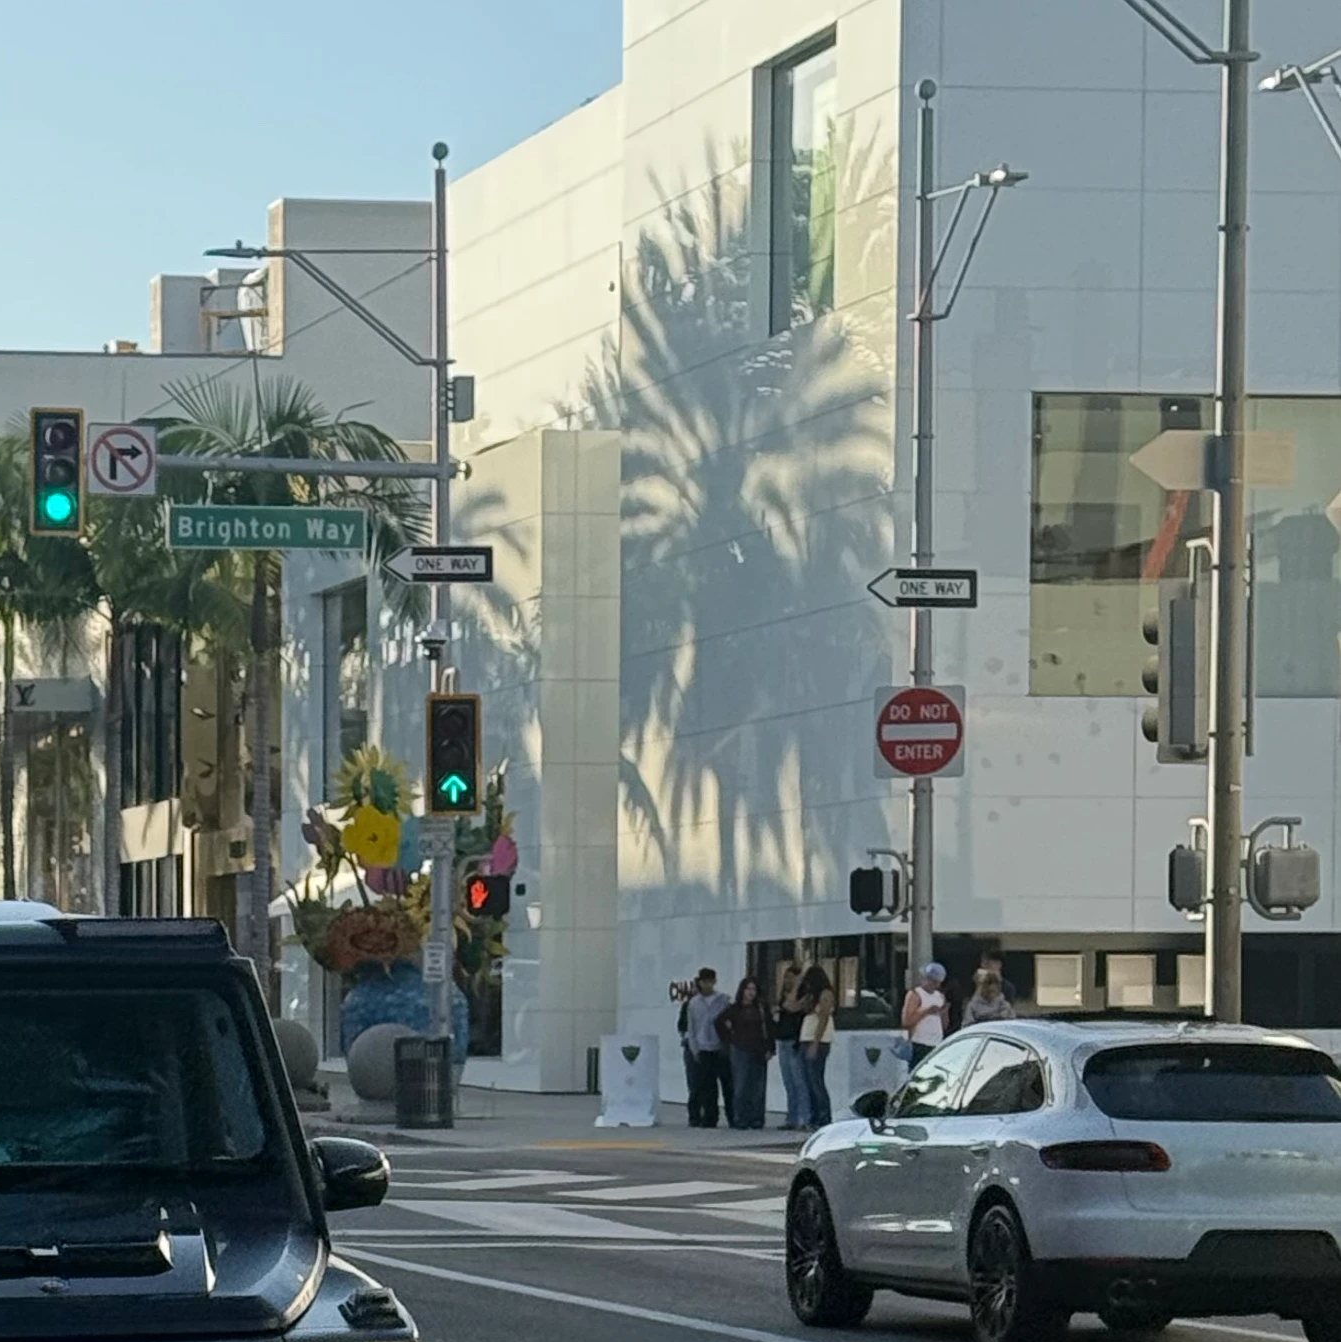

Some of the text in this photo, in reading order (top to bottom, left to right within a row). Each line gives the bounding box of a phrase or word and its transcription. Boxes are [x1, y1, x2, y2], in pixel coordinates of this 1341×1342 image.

[177, 516, 356, 544] Brighton Way
[415, 557, 480, 571] ONE WAY
[899, 581, 964, 596] ONE WAY
[889, 704, 950, 720] DO NOT
[894, 745, 943, 760] ENTER
